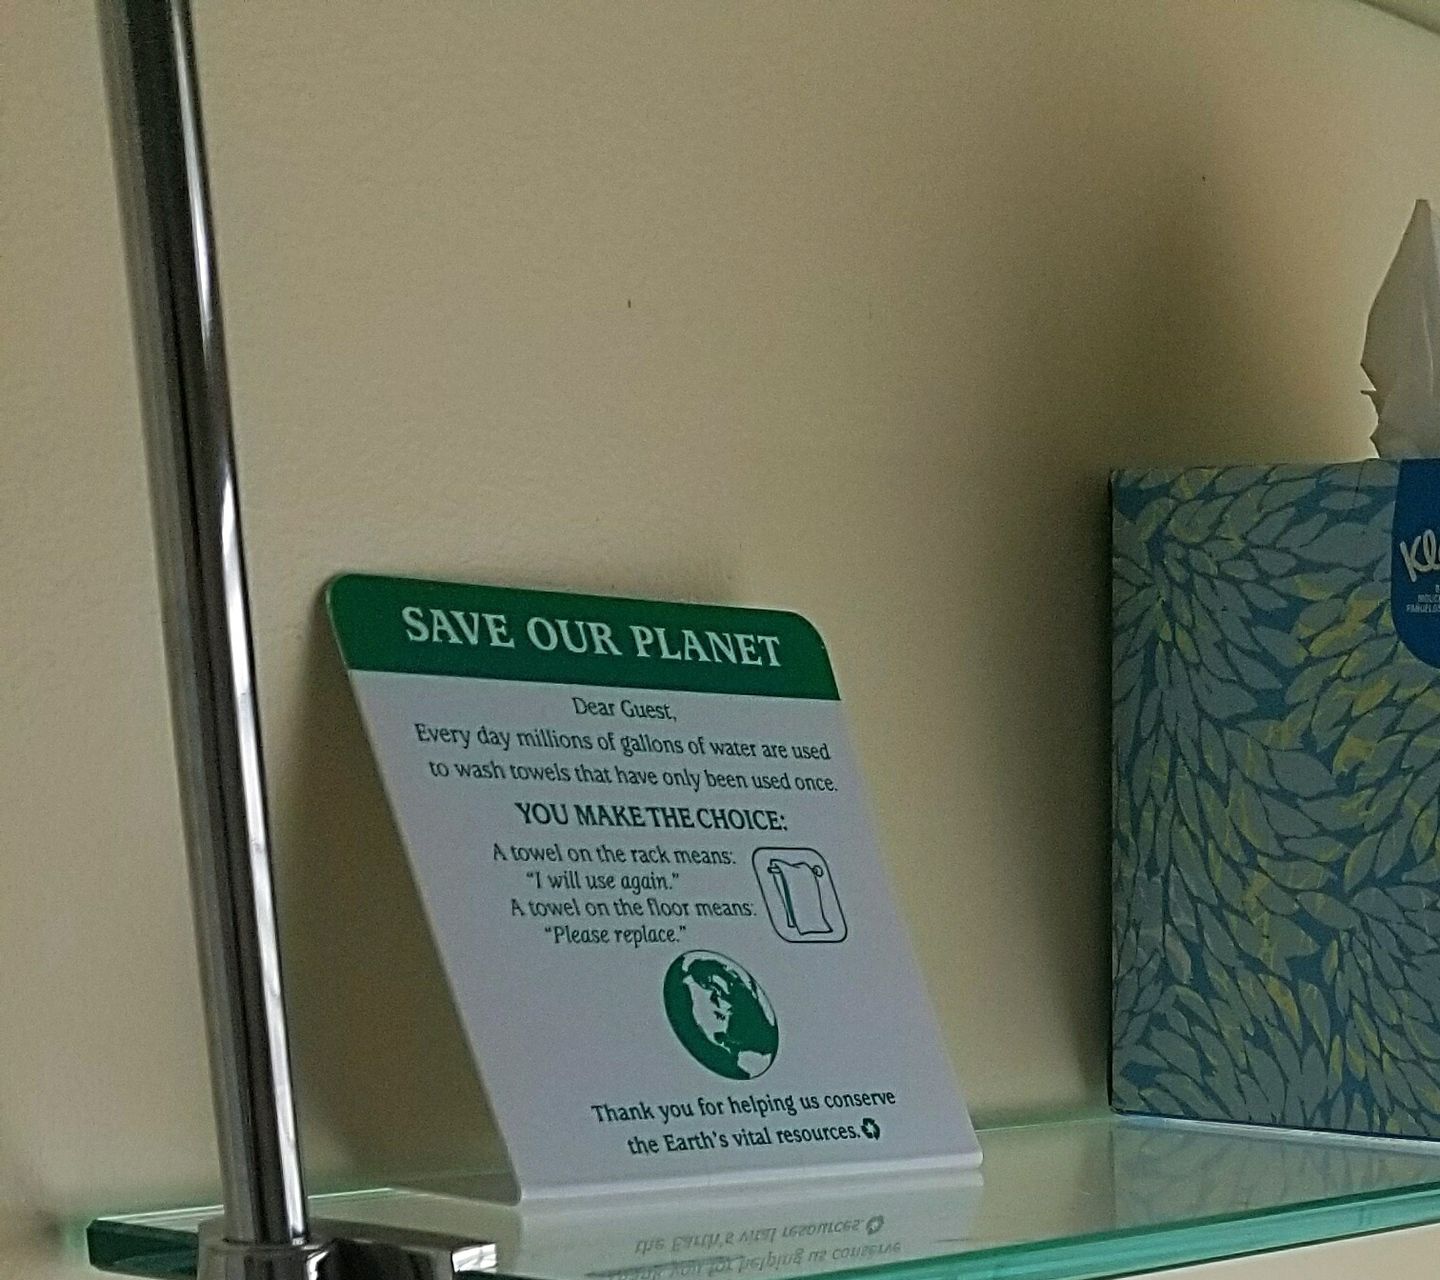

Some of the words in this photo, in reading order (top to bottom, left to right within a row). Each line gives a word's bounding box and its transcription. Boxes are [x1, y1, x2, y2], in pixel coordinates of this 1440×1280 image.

[401, 606, 515, 649] SAVE
[526, 616, 624, 656] OUR
[629, 625, 782, 667] PLANET
[571, 697, 615, 716] Dear
[620, 700, 677, 722] Guest,
[414, 723, 470, 749] Every
[477, 726, 510, 751] day
[516, 728, 593, 750] millions
[597, 732, 616, 751] of
[620, 734, 684, 757] gallons
[687, 736, 705, 754] of
[708, 741, 757, 757] water
[761, 744, 788, 759] are
[791, 743, 831, 760] used
[428, 761, 450, 777] to
[454, 761, 506, 779] wash
[510, 763, 571, 781] towels
[574, 764, 612, 783] that
[615, 765, 658, 785] have
[662, 768, 700, 792] only
[704, 769, 751, 788] been
[751, 772, 791, 790] used
[795, 776, 838, 791] once.
[514, 802, 569, 825] YOU
[573, 804, 646, 827] MAKE
[645, 806, 695, 828] THE
[696, 808, 788, 831] CHOICE:
[493, 843, 507, 861] A
[510, 843, 563, 861] towel
[567, 847, 593, 862] on
[596, 844, 627, 862] the
[631, 845, 671, 864] rack
[674, 849, 736, 865] means:
[547, 870, 581, 889] will
[585, 875, 616, 890] use
[511, 899, 525, 916] A
[528, 898, 581, 917] towel
[585, 902, 610, 917] on
[613, 898, 644, 916] the
[647, 898, 689, 916] floor
[695, 902, 757, 917] means:
[591, 1102, 655, 1122] Thank
[658, 1102, 694, 1125] you
[697, 1097, 724, 1116] for
[727, 1094, 797, 1118] helping
[800, 1096, 820, 1110] us
[824, 1091, 896, 1109] conserve
[627, 1136, 660, 1154] the
[732, 1126, 772, 1147] vital
[776, 1125, 861, 1144] resources.
